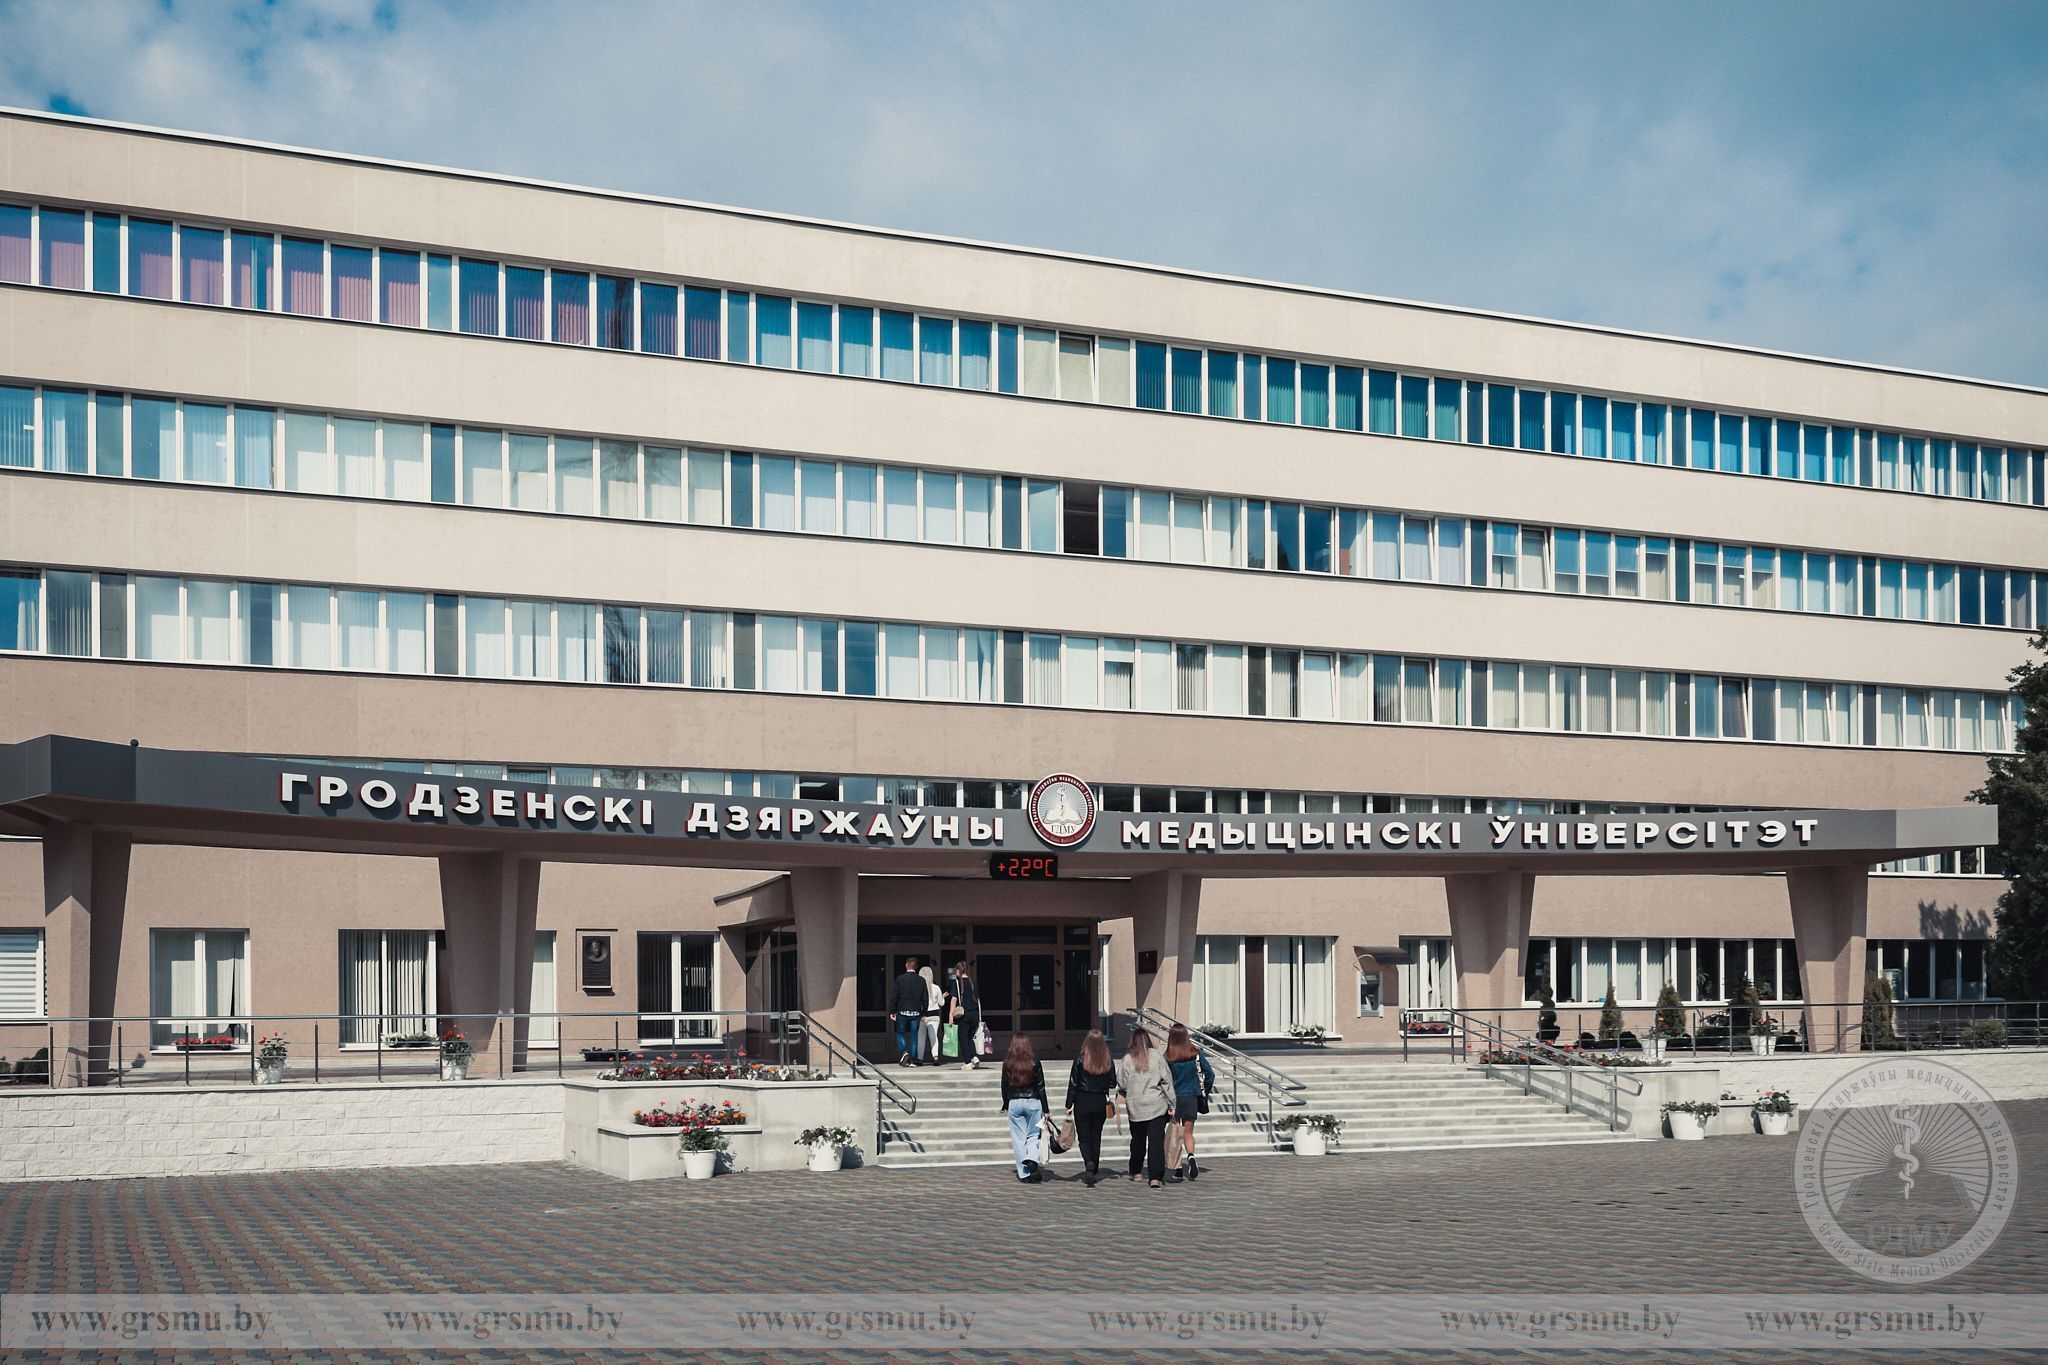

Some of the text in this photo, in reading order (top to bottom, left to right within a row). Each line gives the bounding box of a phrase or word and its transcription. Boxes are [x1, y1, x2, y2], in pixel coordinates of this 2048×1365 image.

[281, 772, 652, 826] ГРОДЗЕНСКІ
[687, 802, 1004, 841] ДЗЯРЖАЎНЫ
[1122, 820, 1461, 849] МЕДЫЦЫНСКІ
[1490, 815, 1818, 845] ЎНІВЕРСІТЭТ
